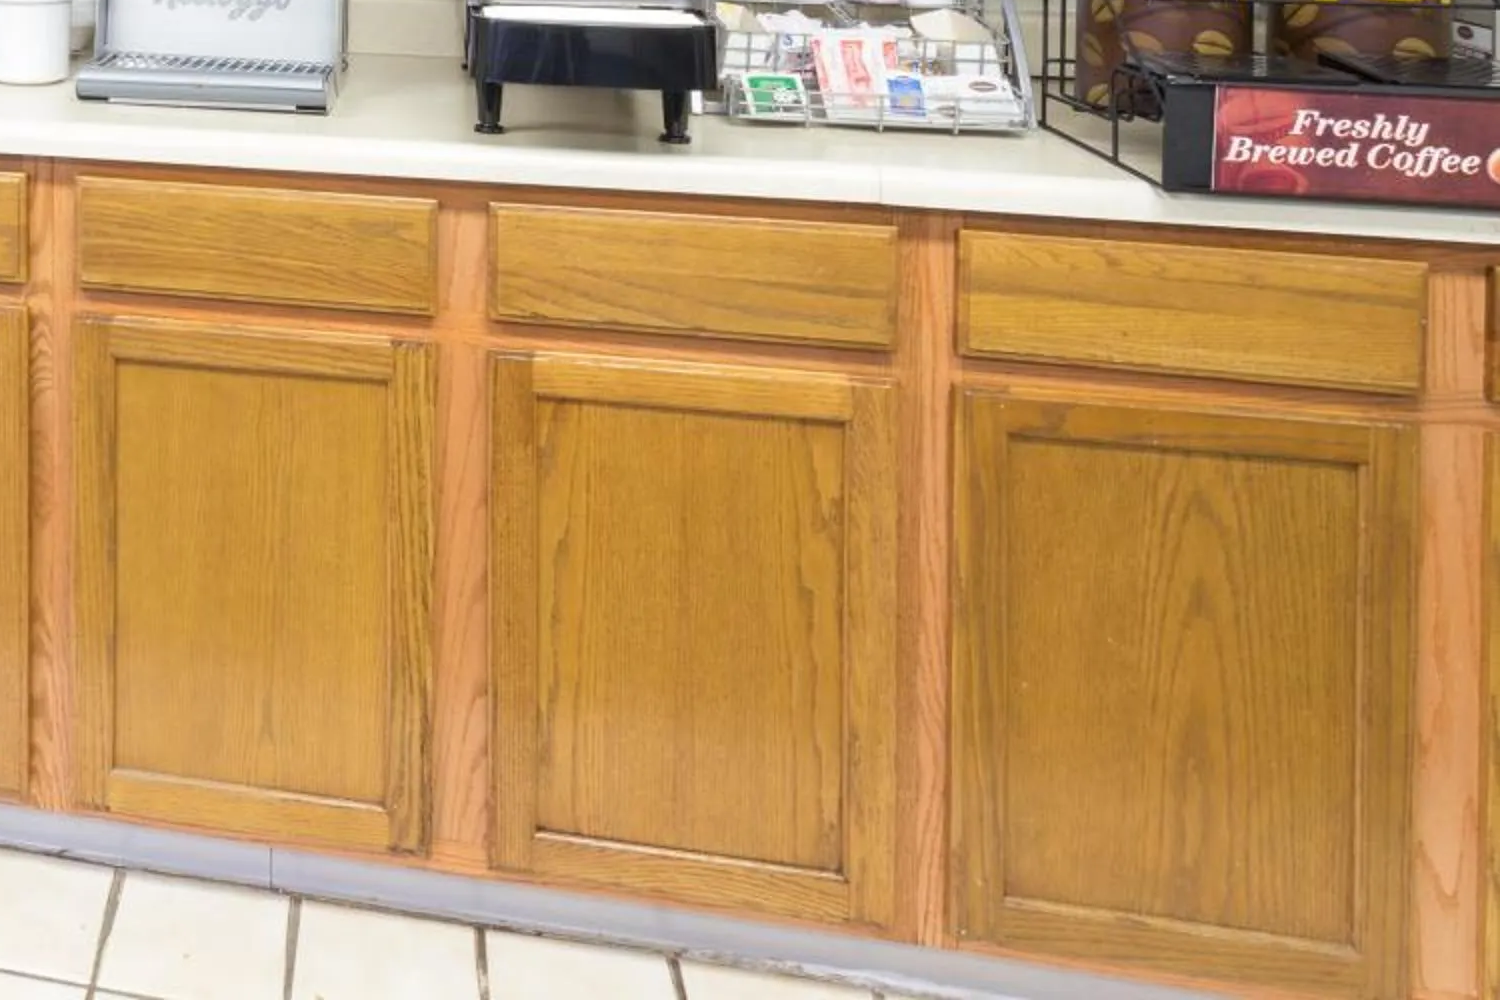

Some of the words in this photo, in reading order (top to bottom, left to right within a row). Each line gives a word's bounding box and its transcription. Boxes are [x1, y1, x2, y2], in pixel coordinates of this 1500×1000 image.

[1287, 109, 1430, 147] Freshly
[1223, 136, 1359, 170] Brewed
[1367, 144, 1482, 178] Coffee
